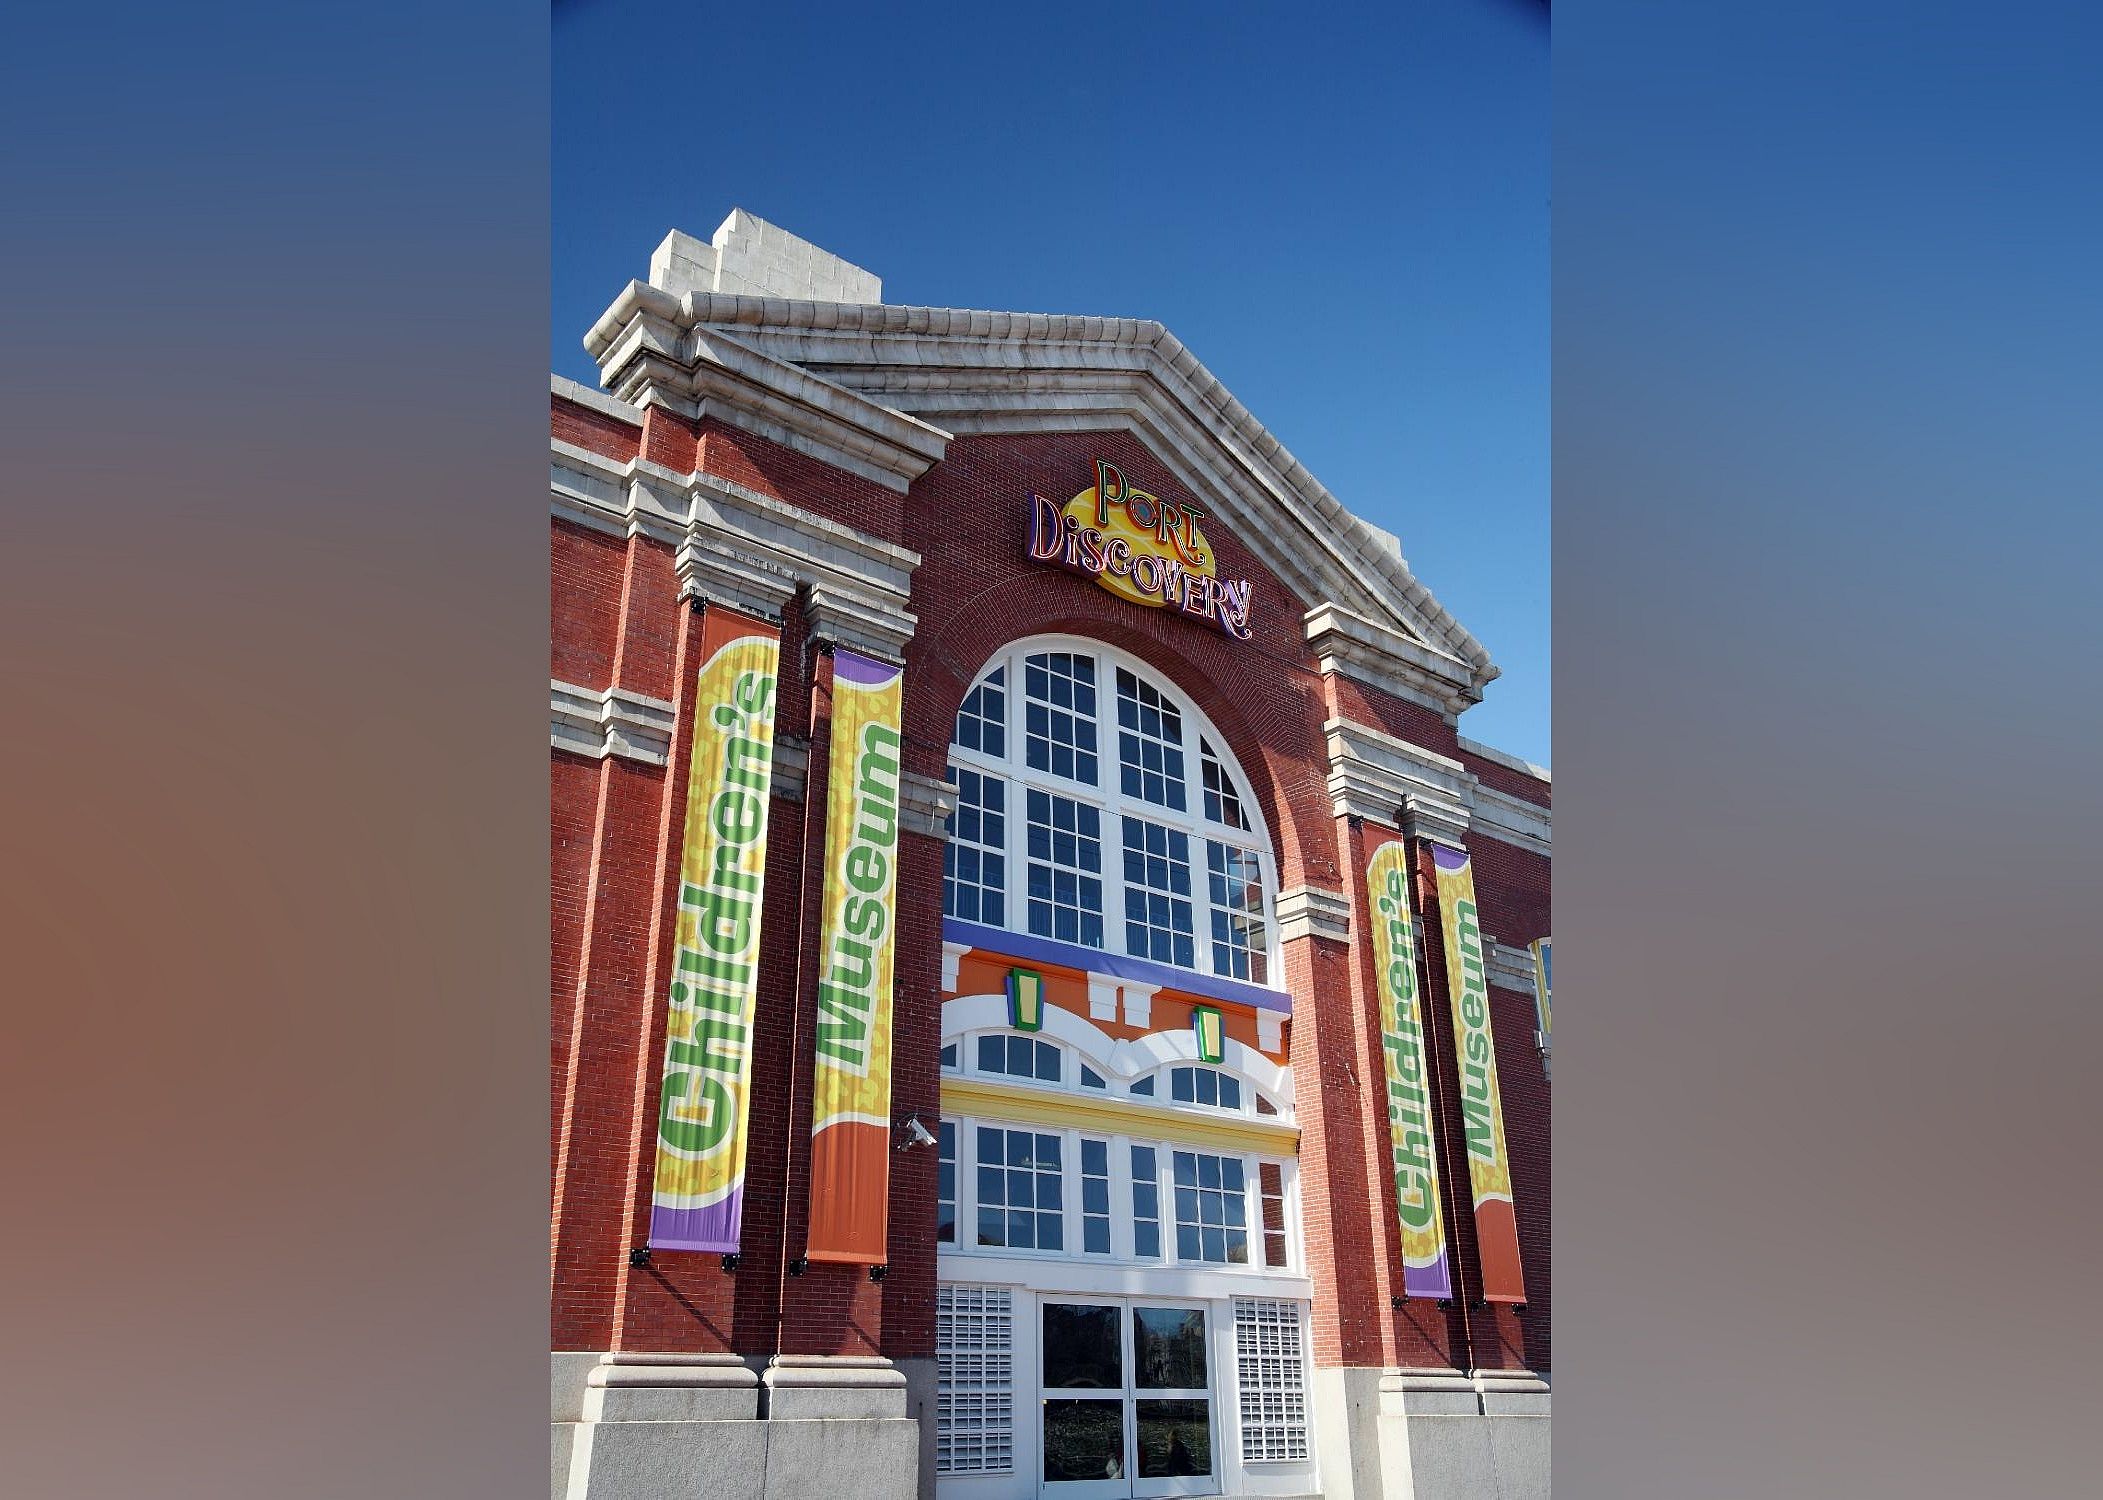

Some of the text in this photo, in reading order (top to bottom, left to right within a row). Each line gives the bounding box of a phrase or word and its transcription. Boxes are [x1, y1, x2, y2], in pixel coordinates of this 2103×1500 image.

[1094, 456, 1205, 568] PORT
[660, 672, 777, 1152] Children's
[815, 724, 900, 1068] Museum
[1378, 868, 1434, 1228] Children's
[1457, 899, 1493, 1159] Museum
